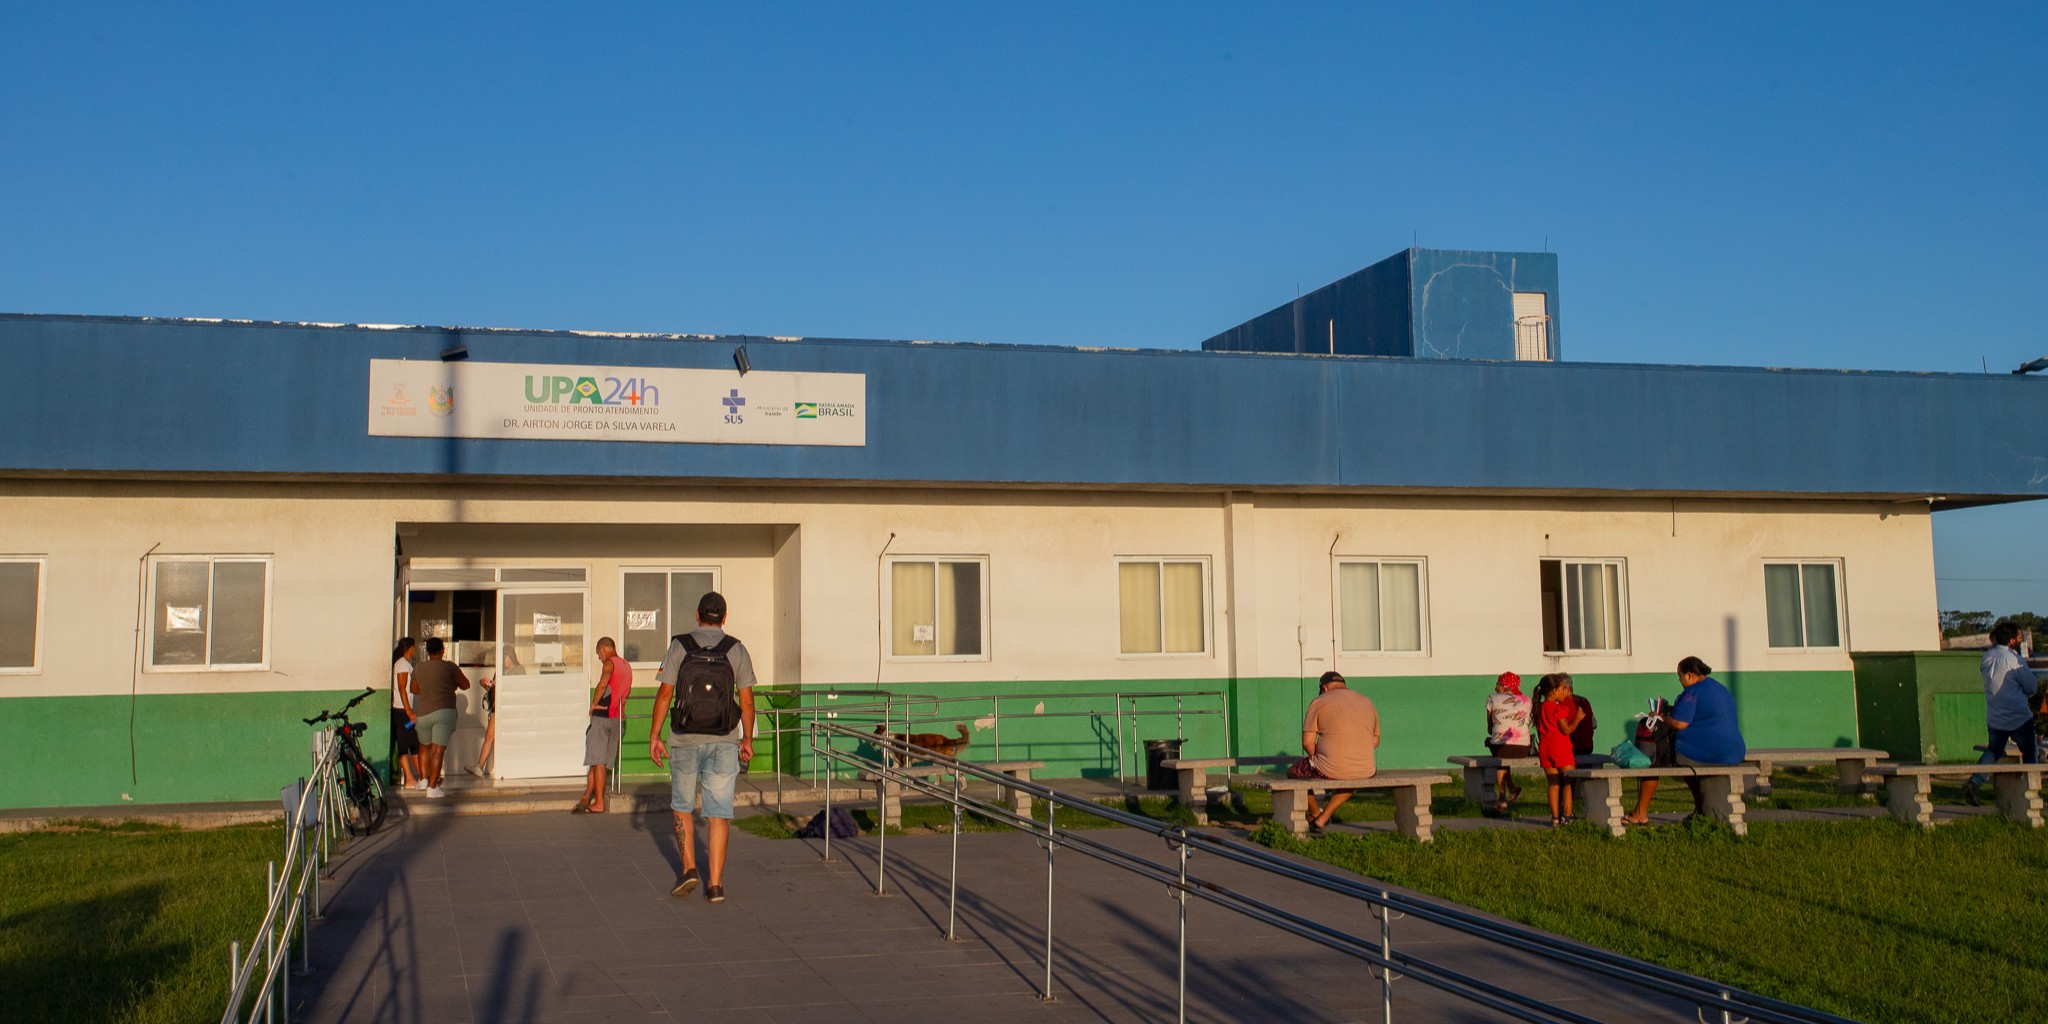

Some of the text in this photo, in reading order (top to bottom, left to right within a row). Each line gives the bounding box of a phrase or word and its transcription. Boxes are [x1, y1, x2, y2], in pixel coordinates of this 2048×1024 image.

[524, 404, 659, 415] UNIDADE DE PRONTO ATENDIMENTO
[818, 407, 855, 417] BRASIL
[503, 418, 676, 432] DR. AIRTON JORGE DA SILVA VARELA
[724, 414, 744, 425] SUS
